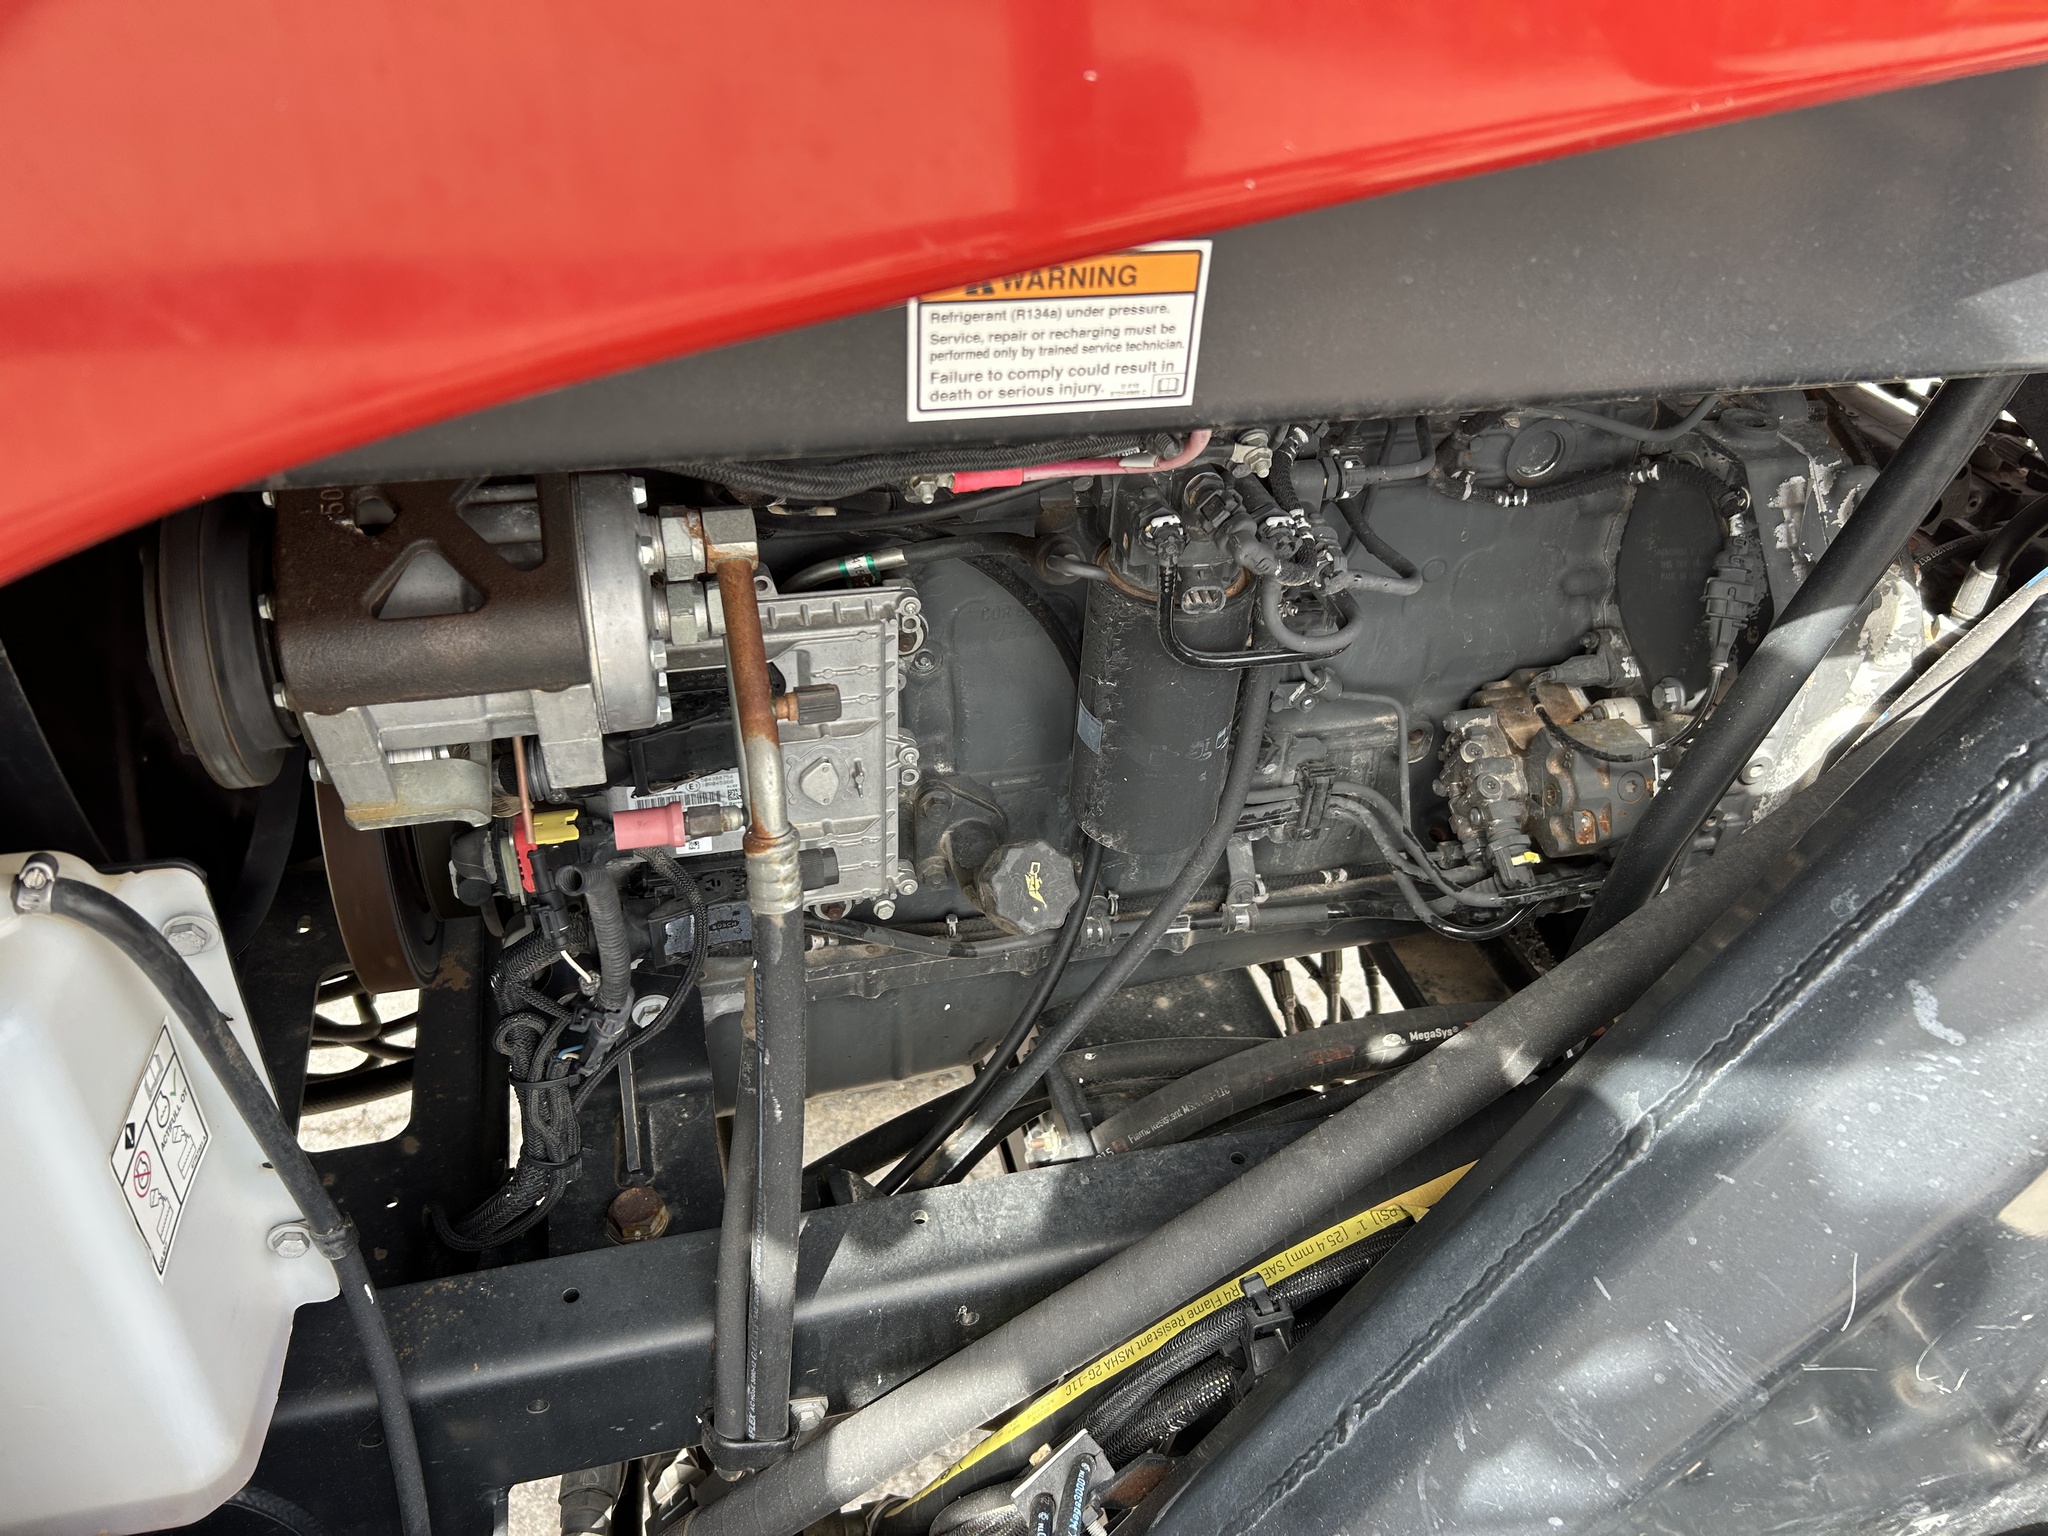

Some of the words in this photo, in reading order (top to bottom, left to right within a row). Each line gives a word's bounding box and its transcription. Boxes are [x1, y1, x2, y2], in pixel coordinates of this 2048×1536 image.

[1002, 265, 1137, 292] WARNING
[930, 310, 1007, 325] Refrigerant
[1011, 307, 1062, 323] (R134a)
[1066, 306, 1105, 318] under
[1109, 304, 1171, 317] pressure.
[930, 333, 985, 346] Service,
[988, 330, 1028, 344] repair
[1031, 331, 1046, 341] or
[1049, 327, 1121, 341] recharging
[1124, 325, 1157, 336] must
[1160, 324, 1176, 334] be
[930, 349, 990, 364] performed
[993, 347, 1018, 361] only
[1021, 346, 1036, 359] by
[1039, 344, 1078, 356] trained
[1081, 343, 1123, 354] service
[1125, 340, 1185, 352] technician.
[930, 370, 983, 384] Failure
[987, 369, 1003, 382] to
[1007, 365, 1063, 382] comply
[1068, 363, 1110, 377] could
[1115, 361, 1157, 375] result
[1161, 360, 1175, 372] in
[930, 388, 972, 402] death
[977, 389, 993, 400] or
[998, 385, 1054, 398] serious
[1059, 382, 1105, 398] injury.
[712, 920, 738, 930] BOSCH
[754, 974, 765, 1050] BURGAFLEX
[161, 1105, 182, 1152] ACTIFULL
[1127, 1126, 1152, 1145] Flame
[1148, 1108, 1185, 1132] Resistant
[1261, 1259, 1286, 1280] SAE
[1186, 1293, 1224, 1322] Flame
[1134, 1314, 1188, 1352] Resistant
[1102, 1345, 1138, 1372] MSHA
[1061, 1364, 1106, 1397] 2G-11C
